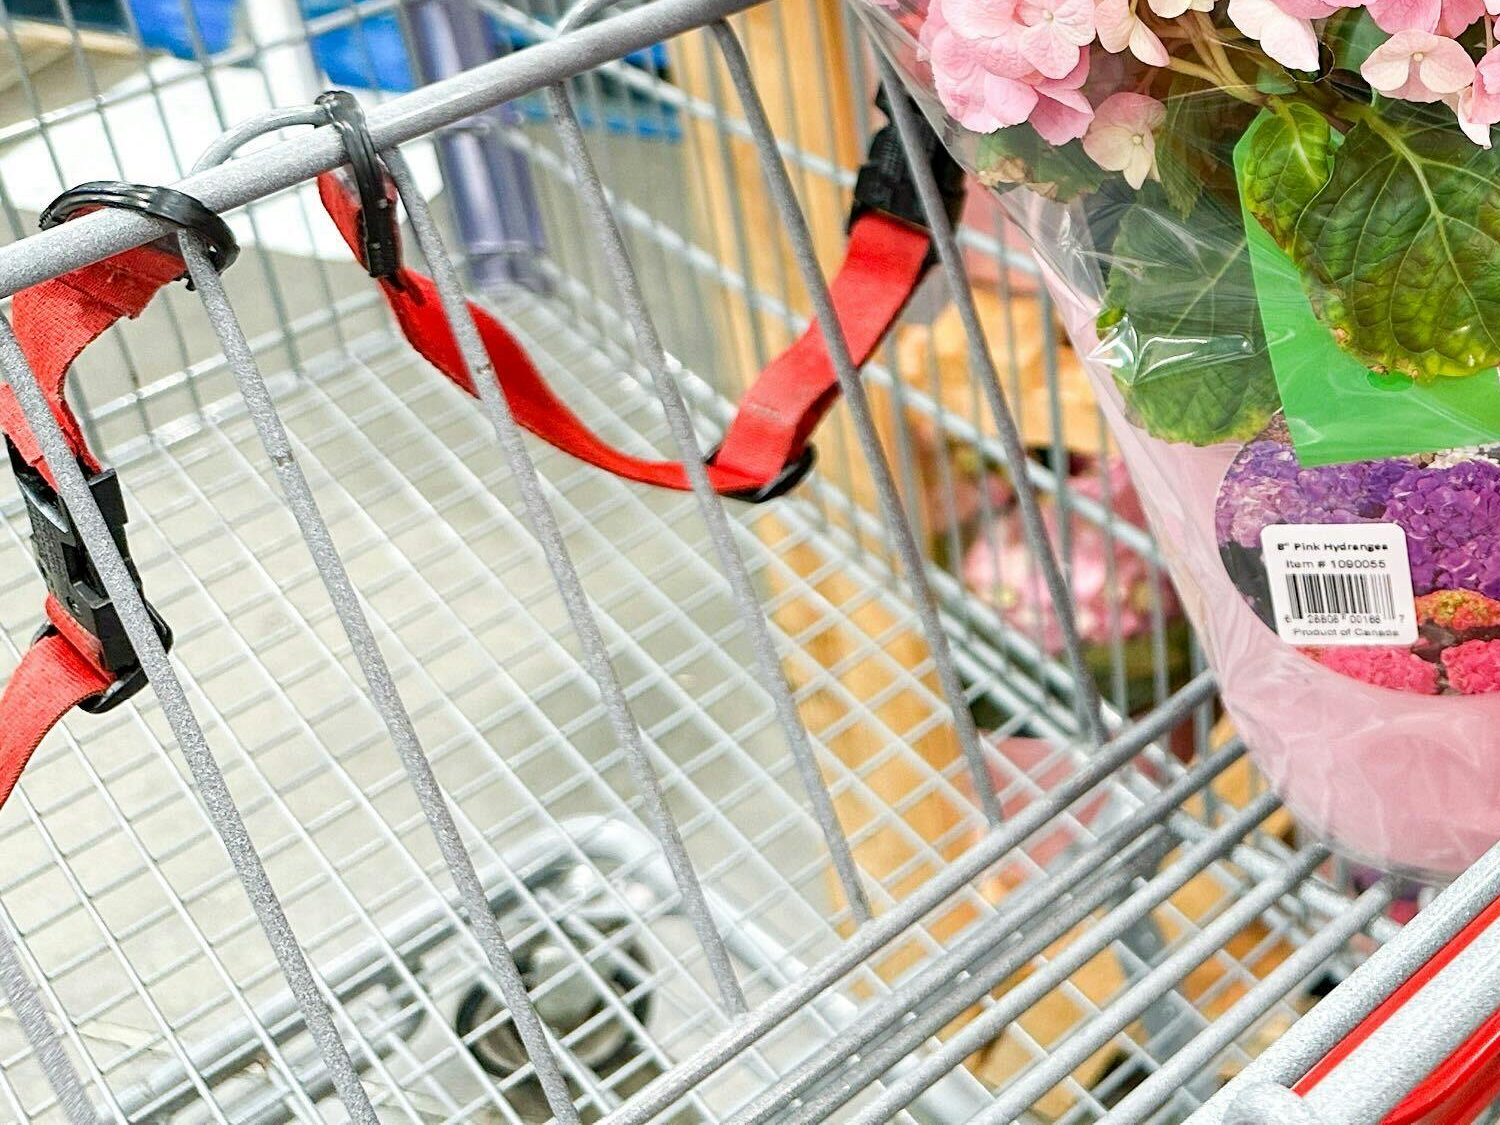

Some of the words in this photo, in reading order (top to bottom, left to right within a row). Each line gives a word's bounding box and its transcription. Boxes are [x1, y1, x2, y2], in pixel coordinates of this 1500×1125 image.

[1294, 542, 1321, 551] Pink
[1324, 542, 1389, 553] Hydrangea
[1286, 560, 1315, 569] Item
[1293, 628, 1337, 636] Product
[1340, 628, 1352, 636] of
[1354, 628, 1400, 637] Canada
